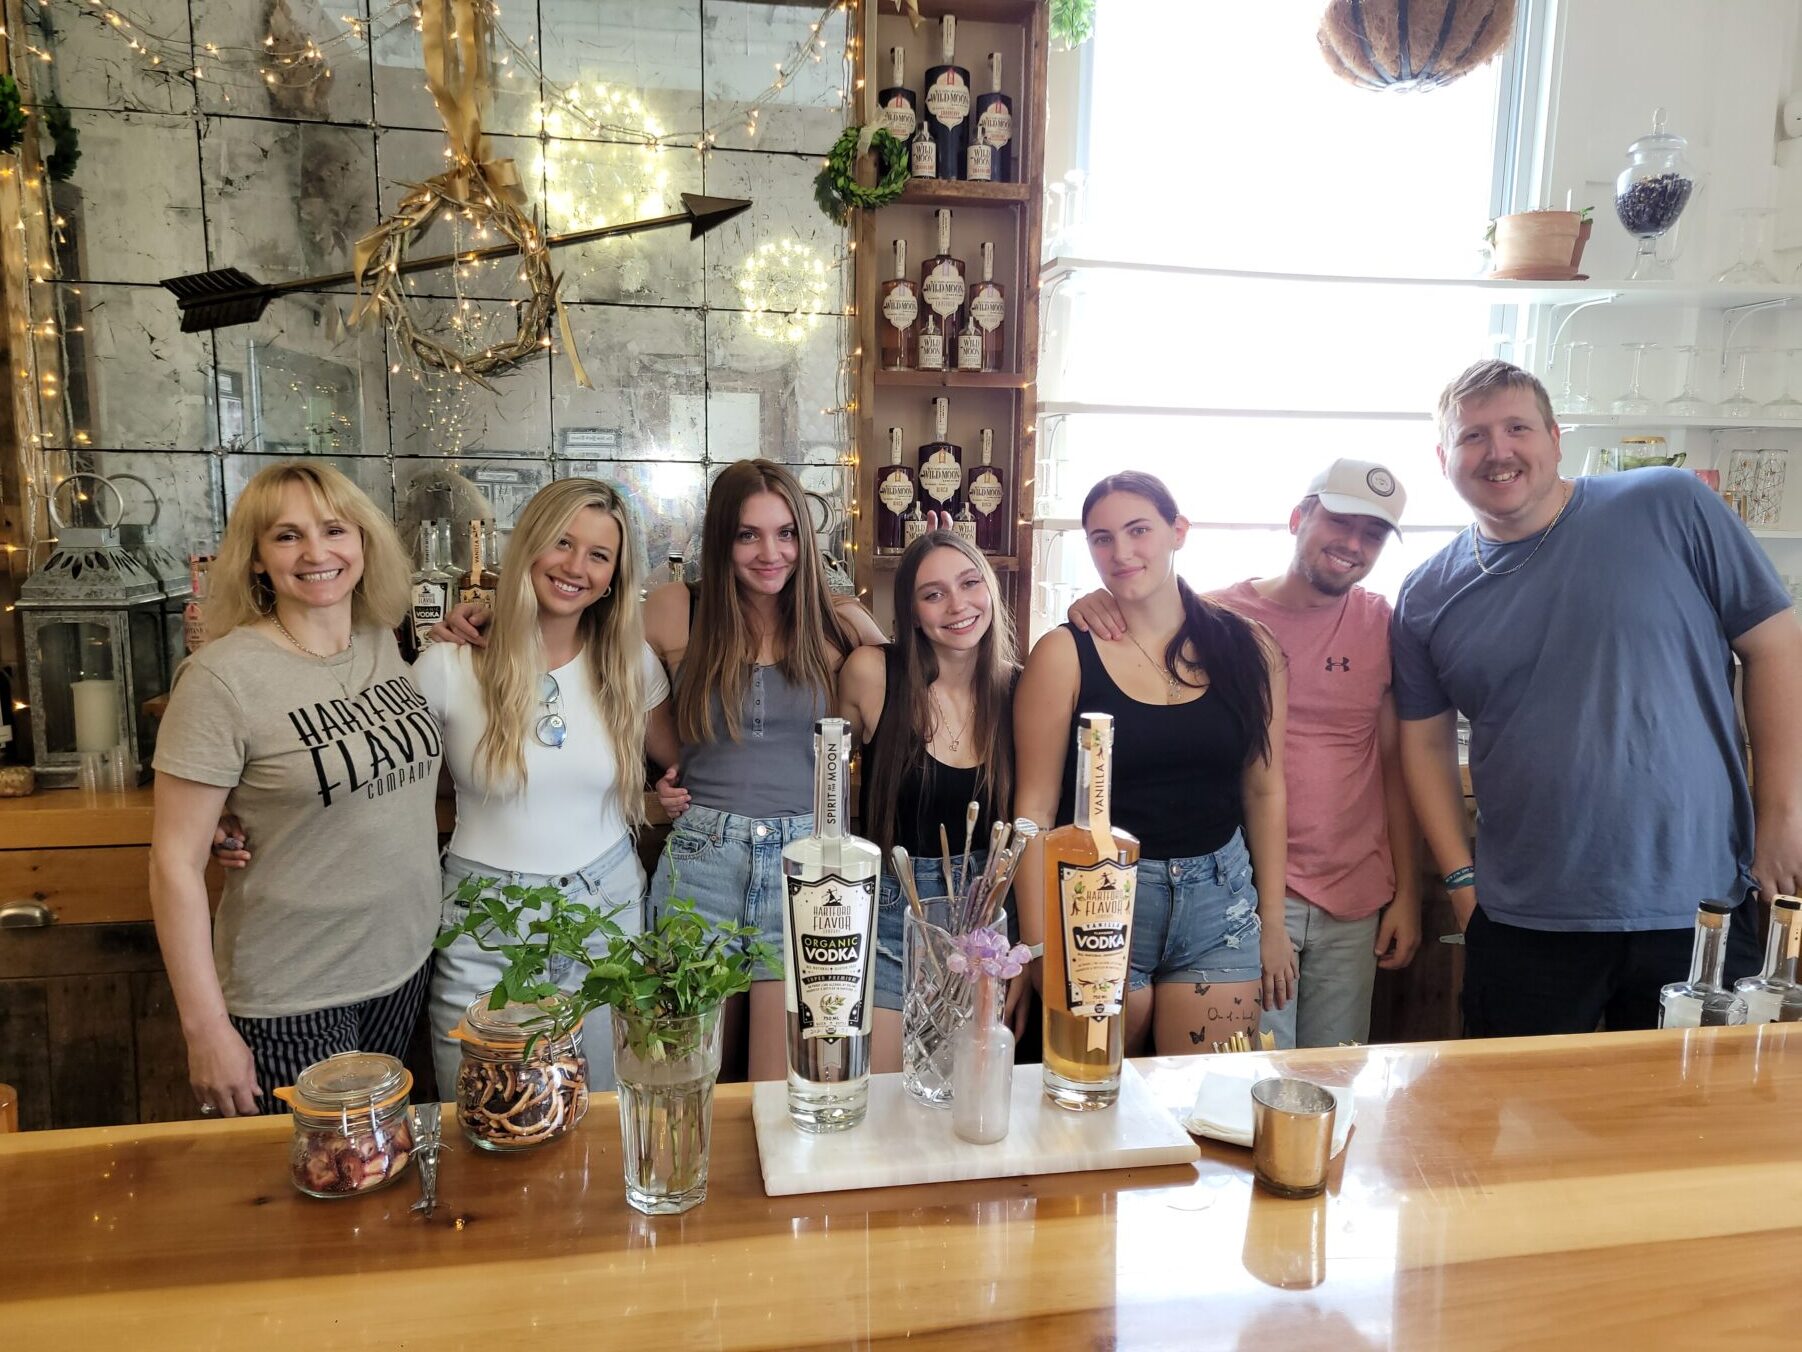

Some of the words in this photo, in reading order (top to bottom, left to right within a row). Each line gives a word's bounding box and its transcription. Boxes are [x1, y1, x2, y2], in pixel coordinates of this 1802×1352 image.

[916, 144, 933, 153] WILD
[926, 283, 944, 293] WILD
[924, 338, 941, 347] WILD
[963, 338, 980, 347] WILD
[923, 470, 941, 480] WILD
[942, 470, 960, 480] MOON
[416, 610, 440, 618] VODKA
[288, 676, 427, 746] HARTFORD
[827, 743, 837, 781] MOON
[367, 759, 433, 800] COMPANY
[1094, 763, 1105, 816] VANILLA
[827, 792, 836, 824] SPIRIT
[813, 905, 852, 917] HARTFORD
[1085, 900, 1122, 917] FLAVOR
[813, 916, 851, 932] FLAVOR
[804, 937, 858, 948] ORGANIC
[1076, 933, 1125, 950] VODKA
[805, 945, 859, 962] VODKA
